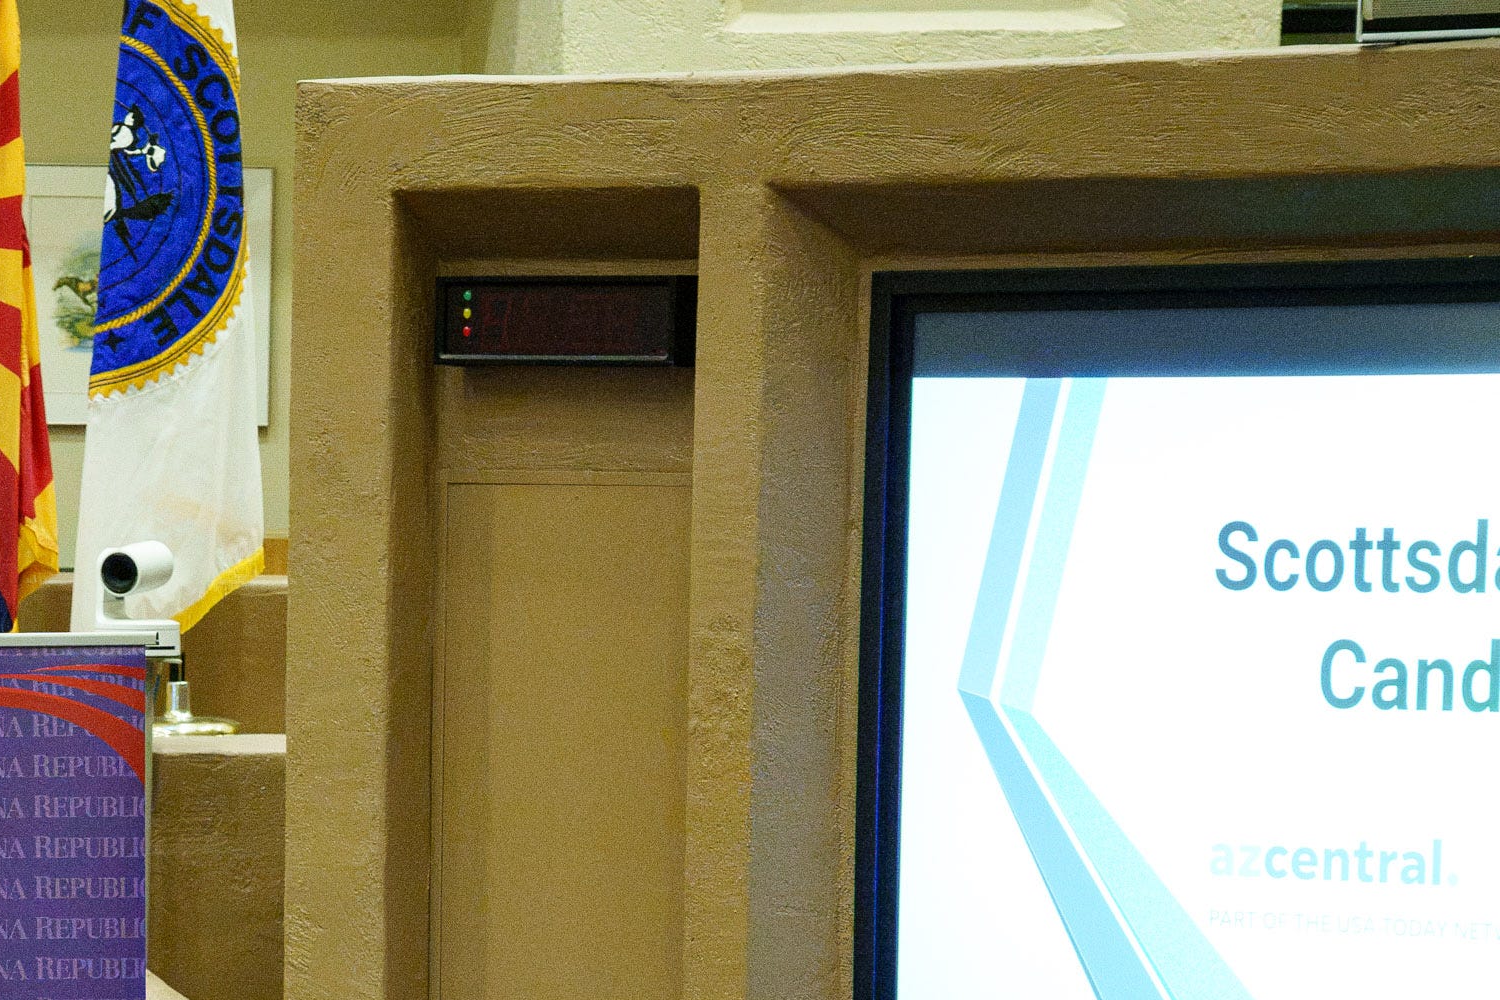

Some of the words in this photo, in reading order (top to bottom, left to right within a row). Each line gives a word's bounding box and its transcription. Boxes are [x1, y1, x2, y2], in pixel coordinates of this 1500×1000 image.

[1215, 518, 1500, 593] Scottsd
[1320, 638, 1500, 713] Cand
[1209, 839, 1459, 886] azcentral.
[1296, 912, 1331, 932] THE
[1337, 914, 1376, 934] USA
[1383, 916, 1447, 938] TODAY
[1454, 921, 1500, 941] NET
